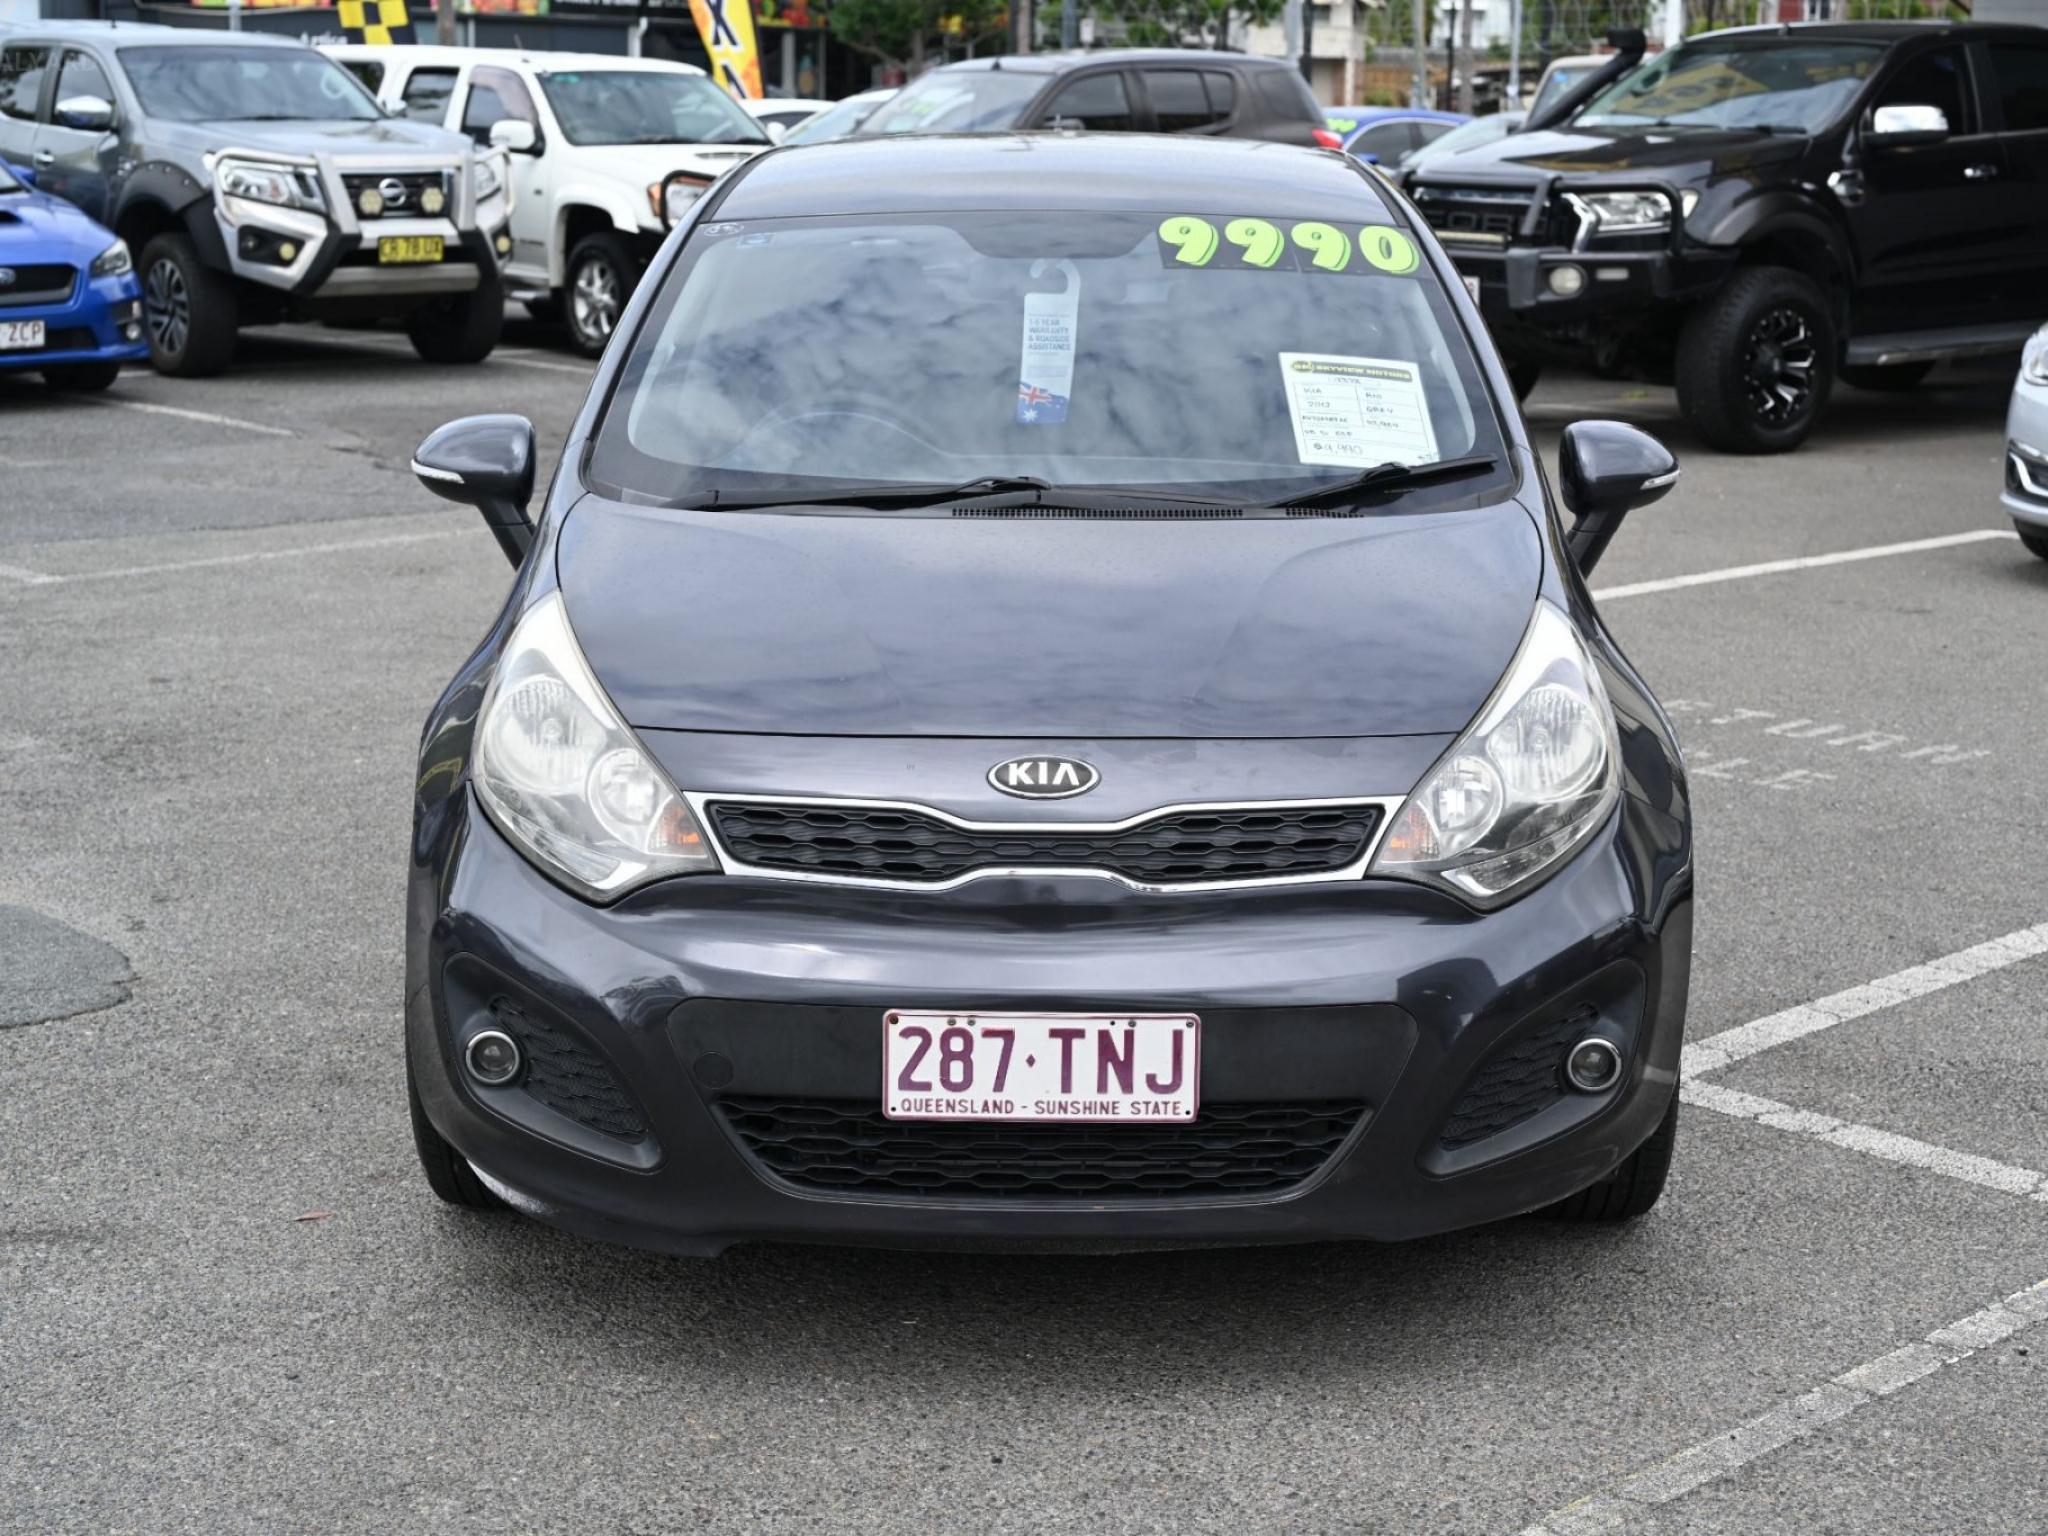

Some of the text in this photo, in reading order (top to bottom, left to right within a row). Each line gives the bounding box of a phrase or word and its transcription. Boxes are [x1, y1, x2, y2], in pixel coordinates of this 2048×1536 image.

[1158, 216, 1420, 275] 9990
[1008, 761, 1080, 786] KIA
[901, 1098, 1014, 1114] QUEENSLAND
[1034, 1100, 1120, 1115] SUNSHINE
[1130, 1100, 1182, 1116] STATE
